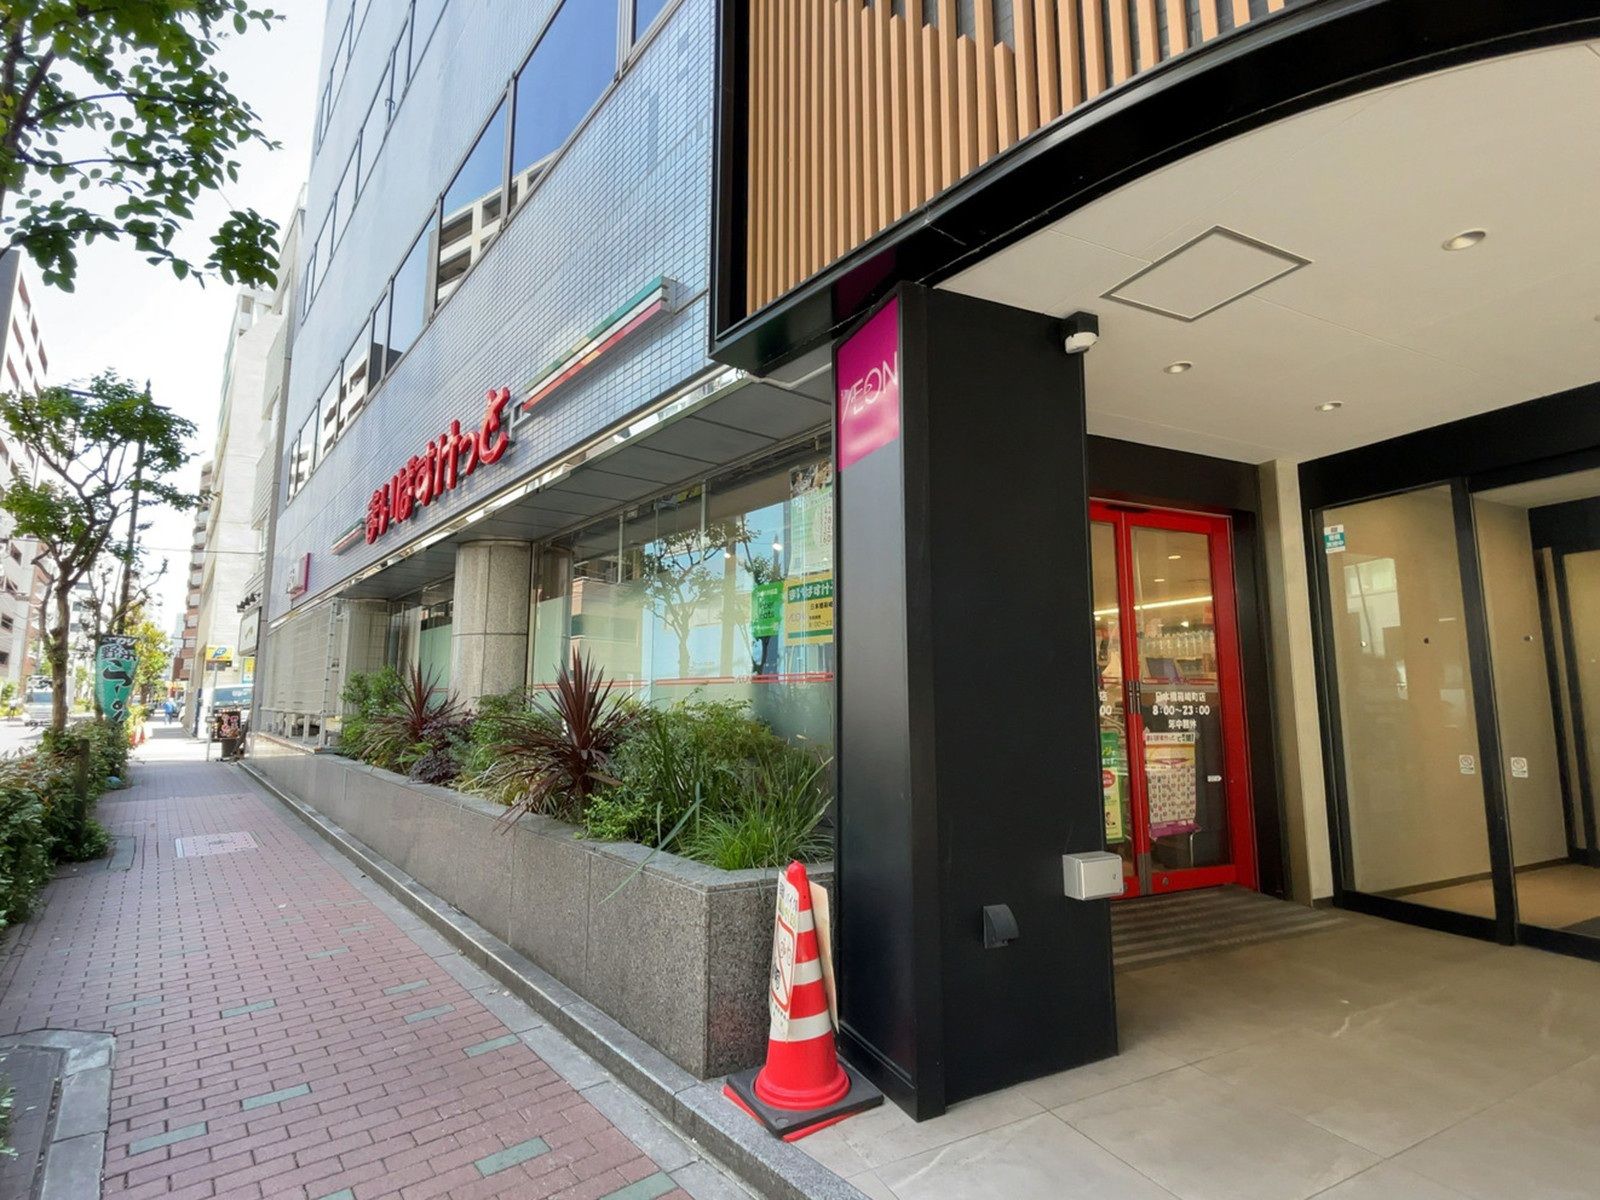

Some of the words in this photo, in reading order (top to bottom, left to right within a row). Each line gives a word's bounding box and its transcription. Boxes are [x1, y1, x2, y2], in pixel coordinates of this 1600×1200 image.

[365, 386, 511, 545] まいばすけっと
[788, 581, 833, 601] まいばすけ
[1168, 719, 1198, 730] 年中無休
